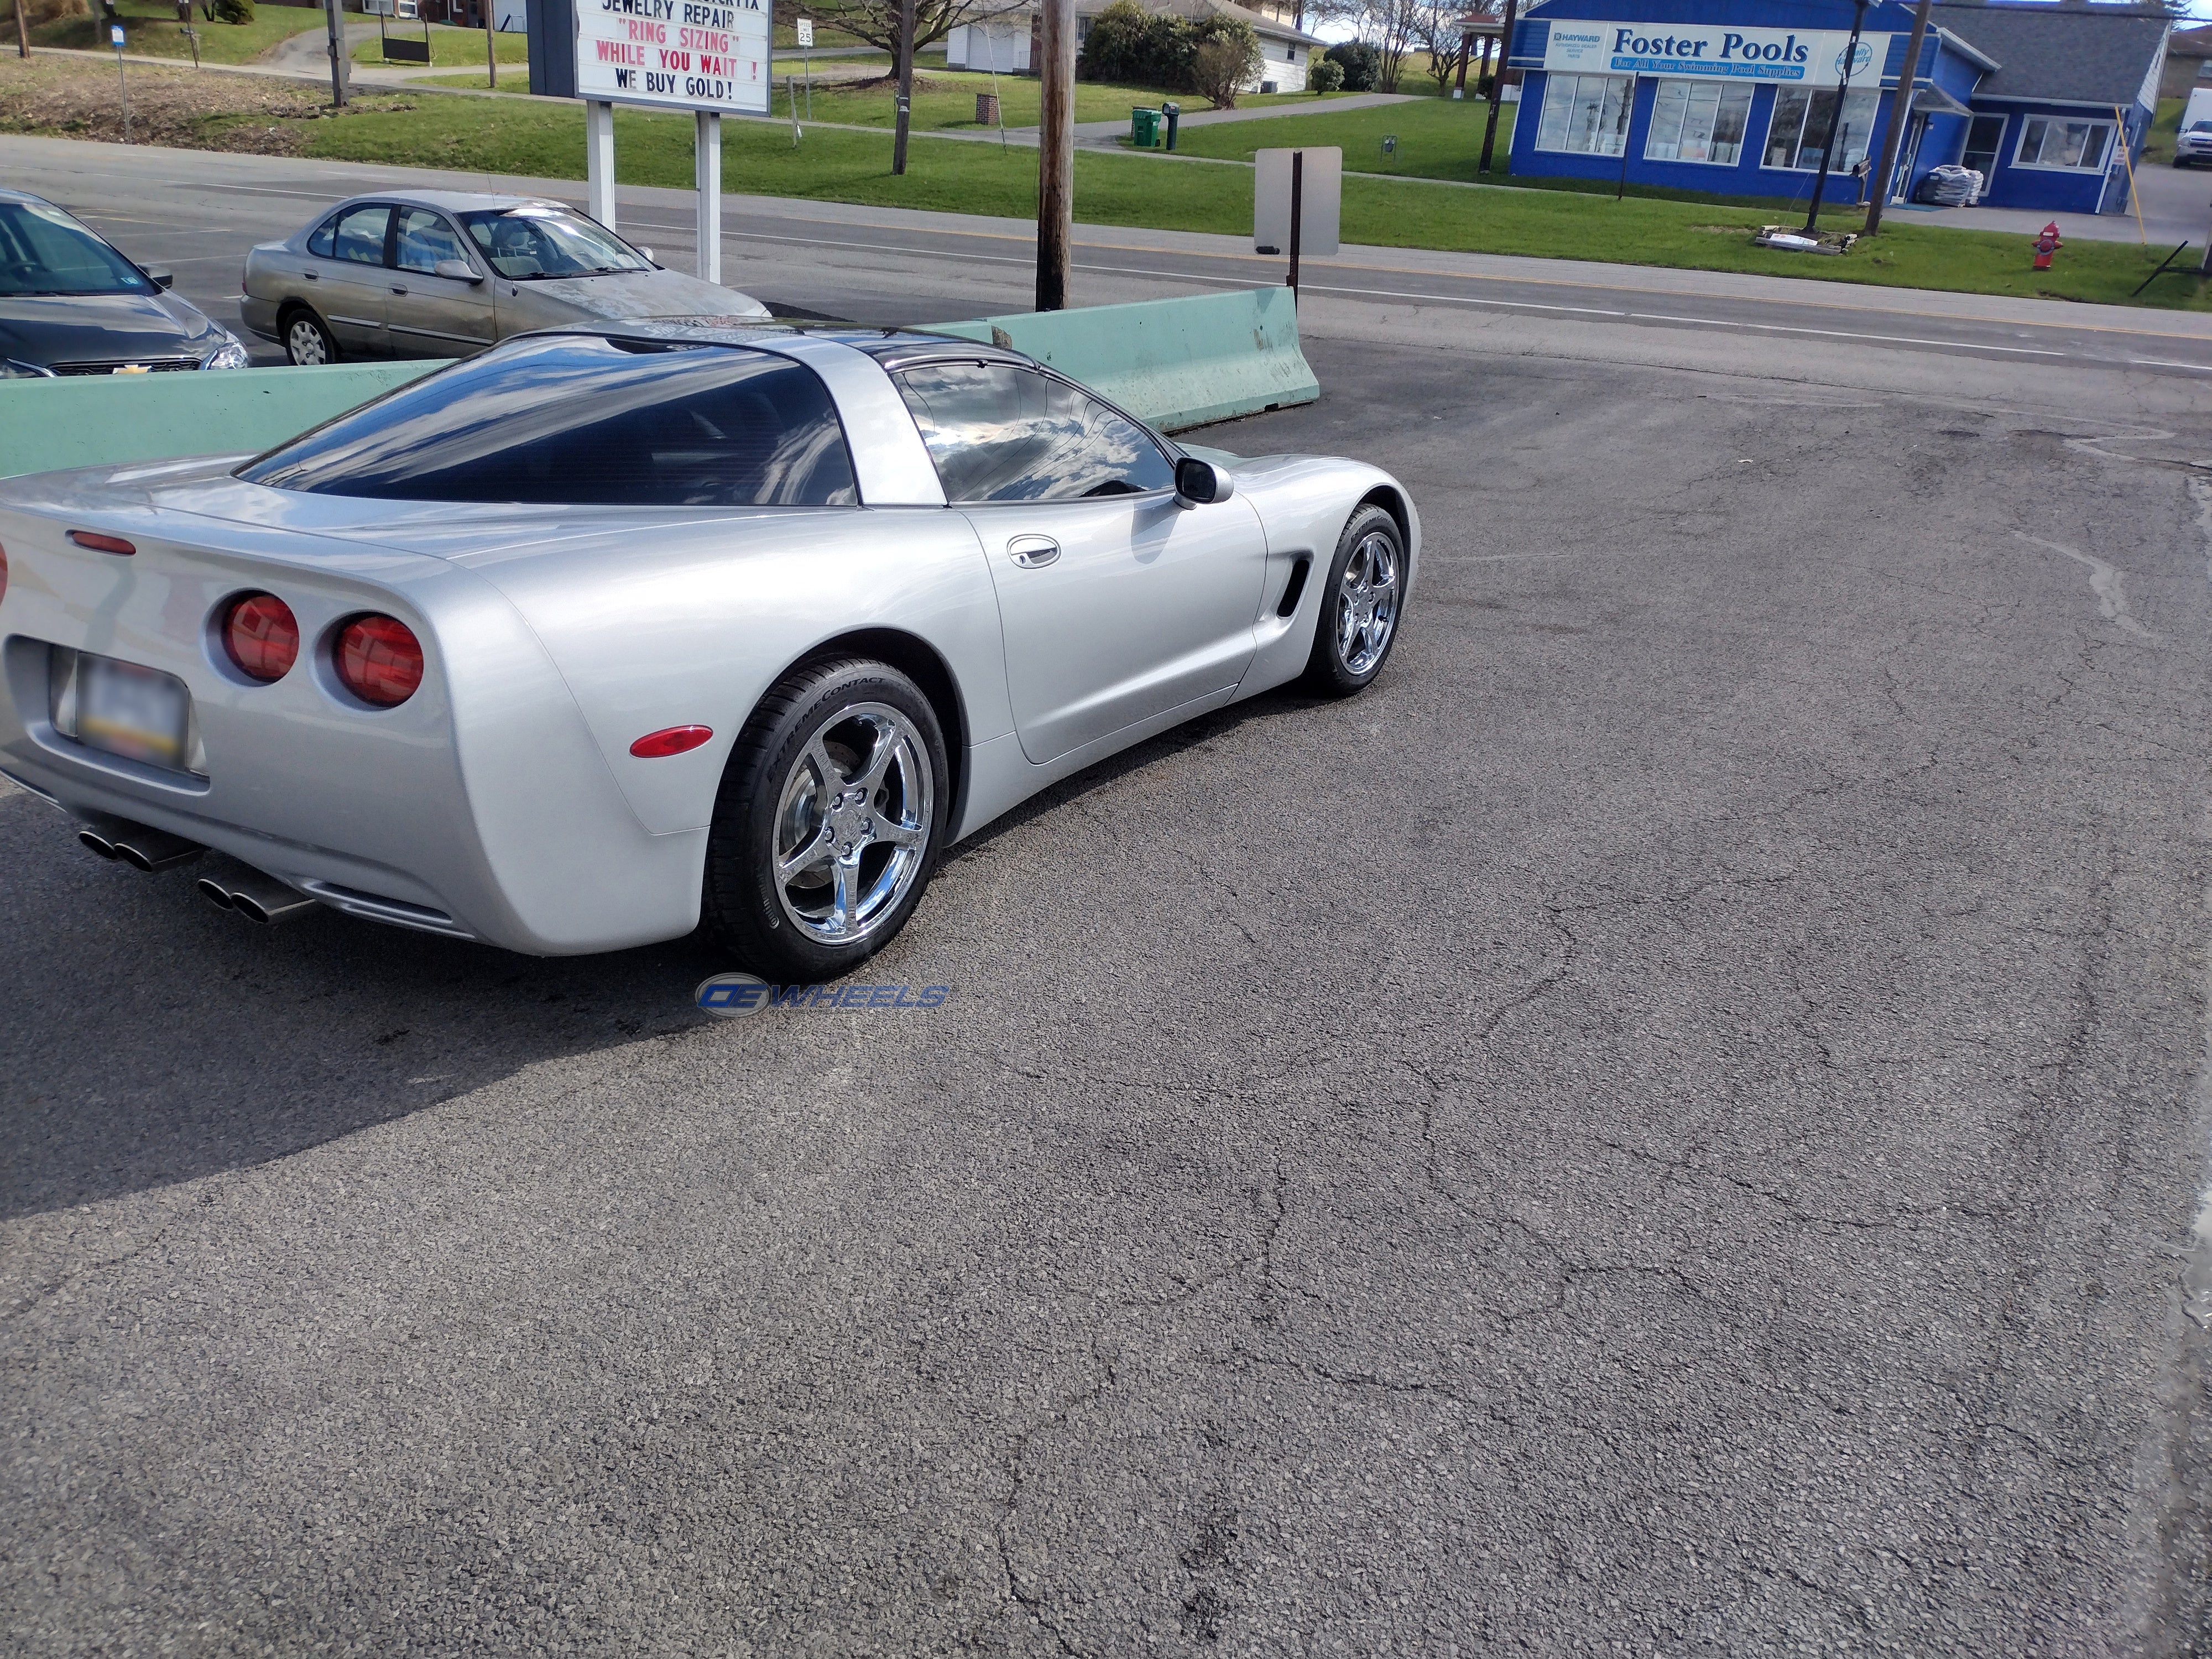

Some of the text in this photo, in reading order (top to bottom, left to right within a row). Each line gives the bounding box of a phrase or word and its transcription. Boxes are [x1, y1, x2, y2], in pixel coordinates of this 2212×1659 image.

[602, 0, 674, 19] JEWELRY
[684, 3, 734, 28] REPAIR
[618, 18, 739, 53] "RING SIZING"
[800, 33, 811, 43] 25
[1562, 34, 1600, 43] HAYWARD
[1612, 28, 1809, 63] Foster Pools
[596, 40, 645, 66] WHILE
[659, 49, 690, 71] YOU
[700, 54, 737, 77] WAIT
[1615, 56, 1800, 78] For All Your Swimming Pool Supplies
[615, 67, 732, 100] WE BUY GOLD!
